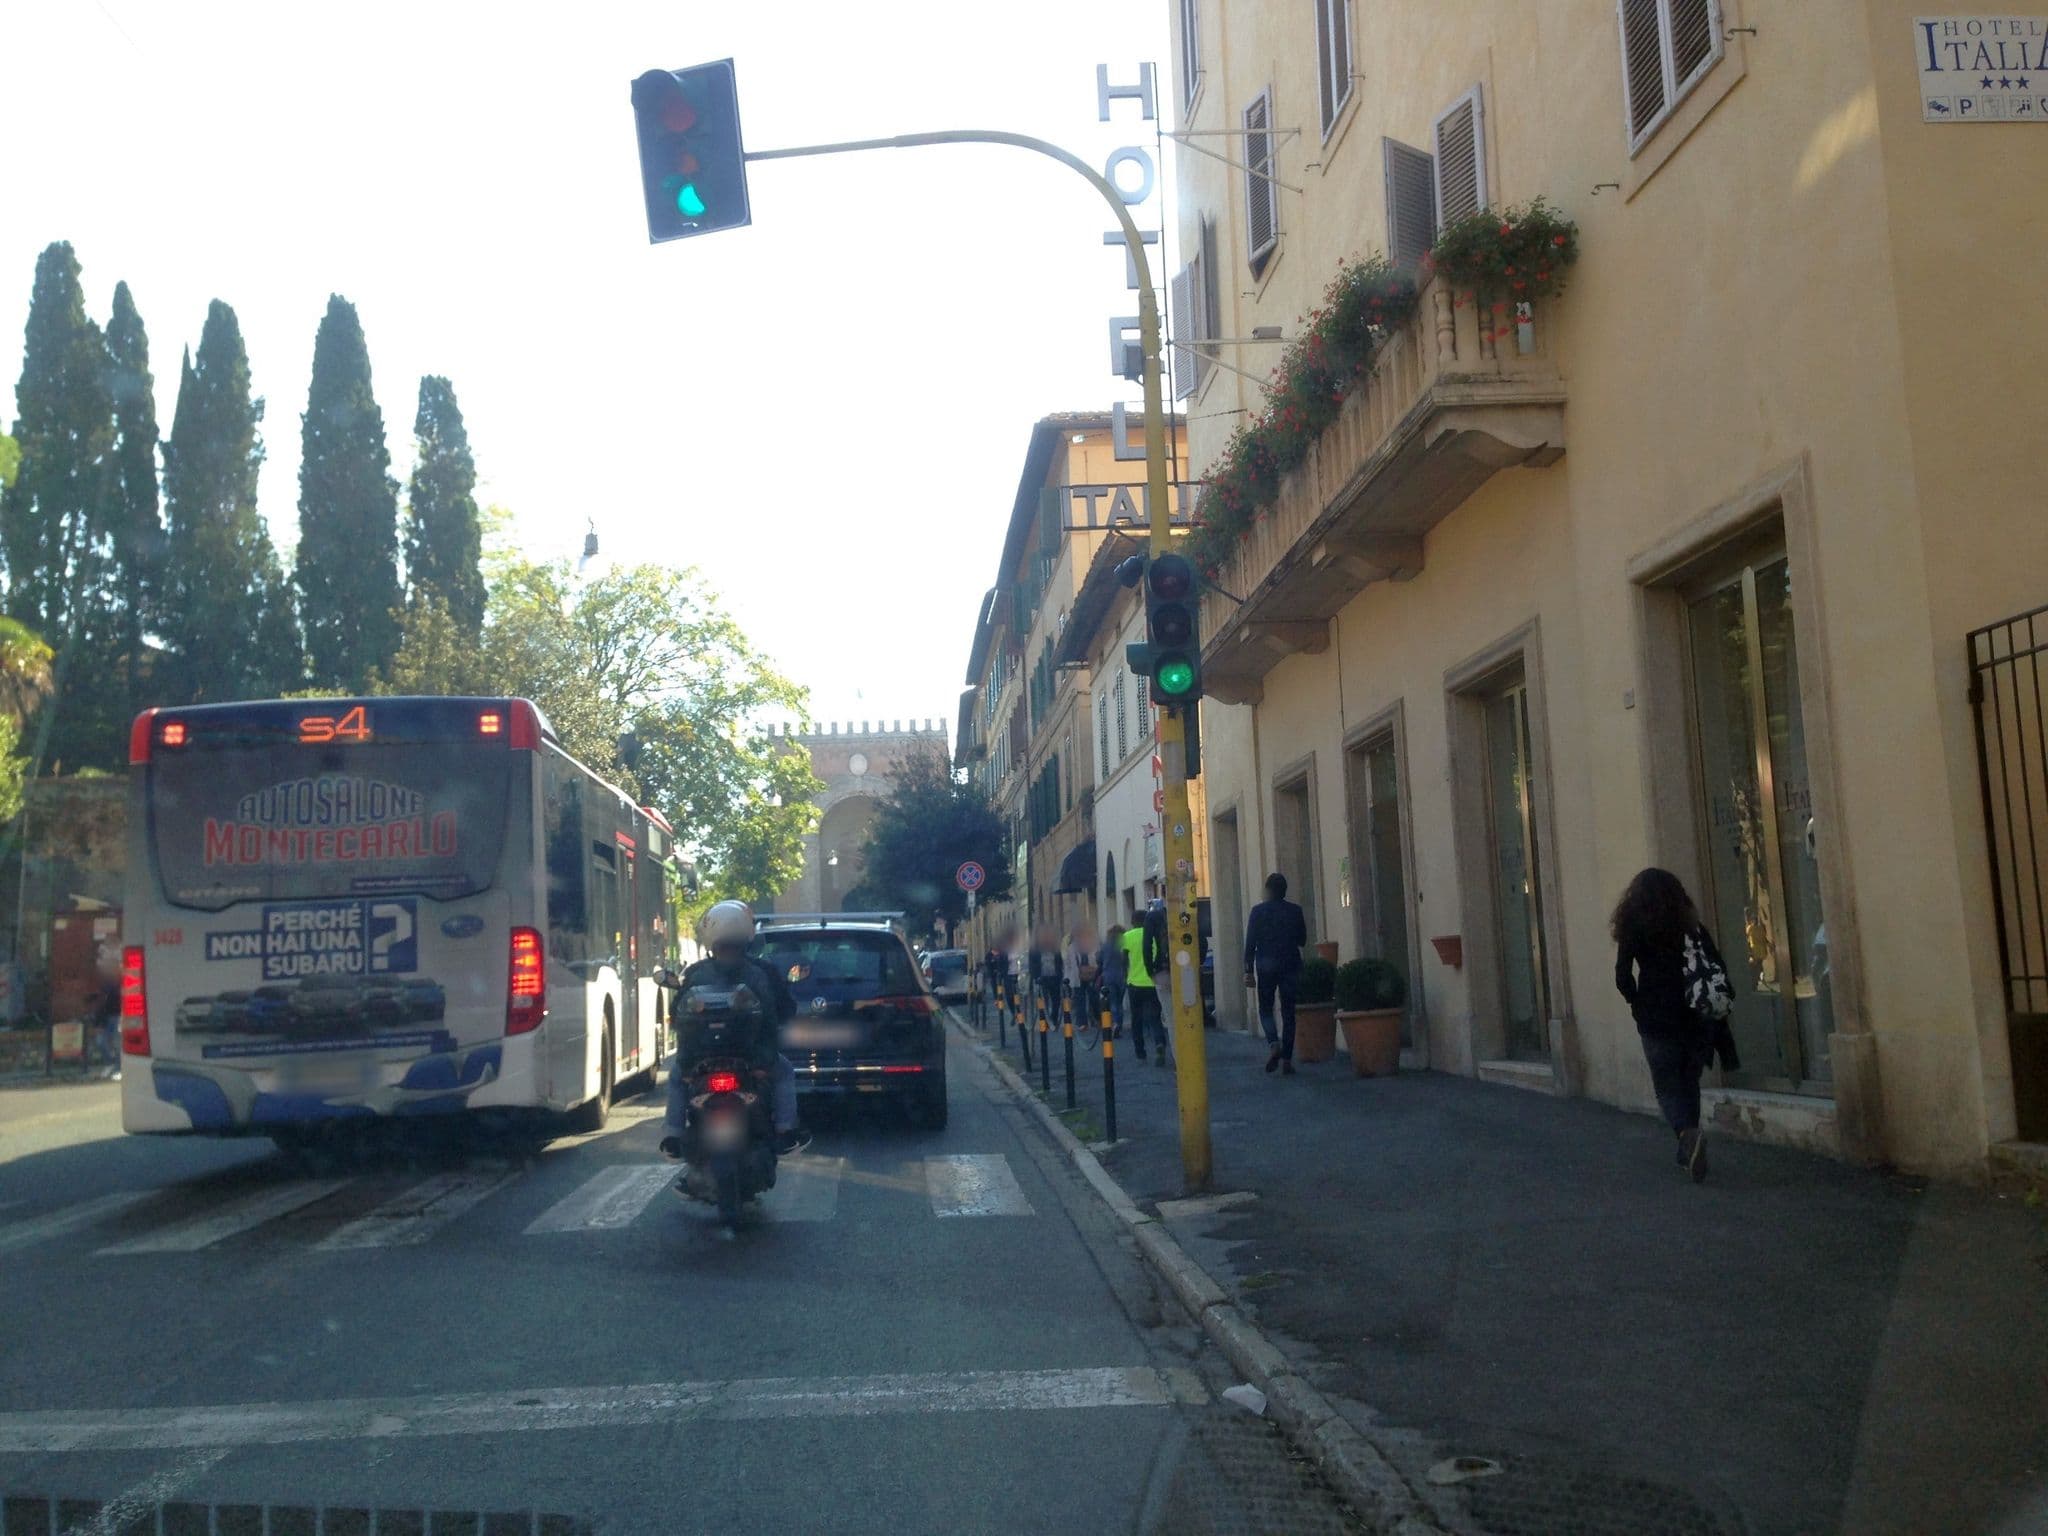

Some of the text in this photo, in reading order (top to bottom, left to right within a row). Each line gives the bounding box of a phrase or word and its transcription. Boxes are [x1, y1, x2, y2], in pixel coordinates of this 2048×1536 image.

[1943, 20, 2042, 37] HOTEL
[237, 776, 425, 825] AUTOSALONE
[205, 811, 458, 866] MONTECARLO
[269, 904, 362, 931] PERCHÉ
[211, 930, 361, 956] NON HAI UNA
[267, 951, 363, 977] SUBARU
